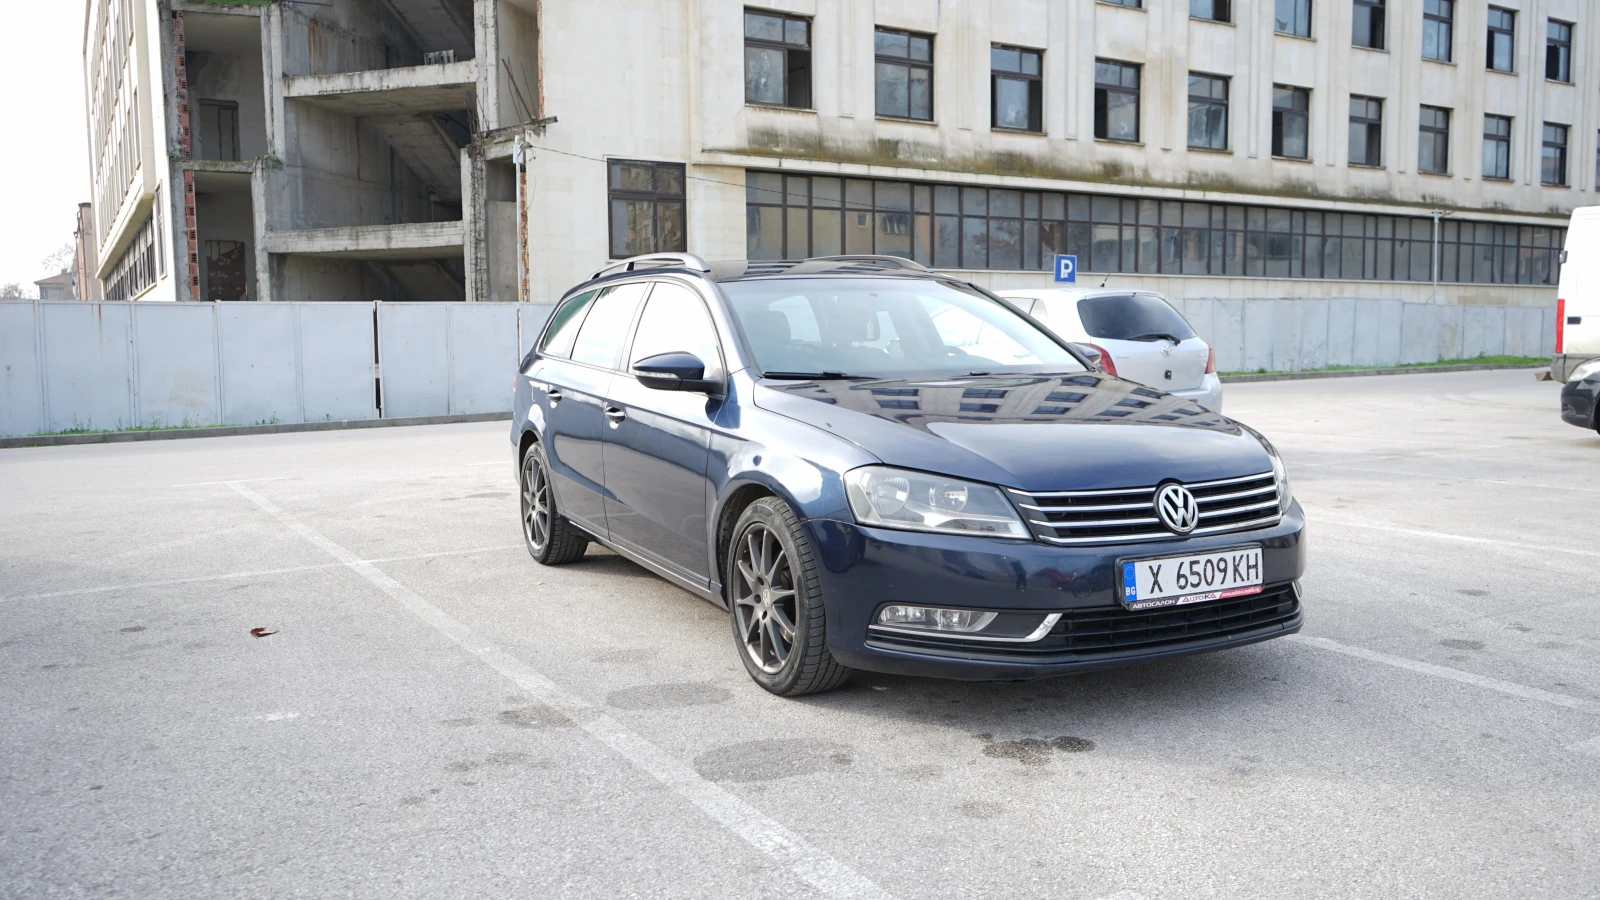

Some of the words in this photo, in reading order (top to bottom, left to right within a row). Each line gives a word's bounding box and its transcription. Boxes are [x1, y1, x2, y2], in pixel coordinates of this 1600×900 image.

[1060, 259, 1073, 279] P
[1126, 586, 1136, 596] BG
[1132, 599, 1176, 609] АВТОСАЛОН
